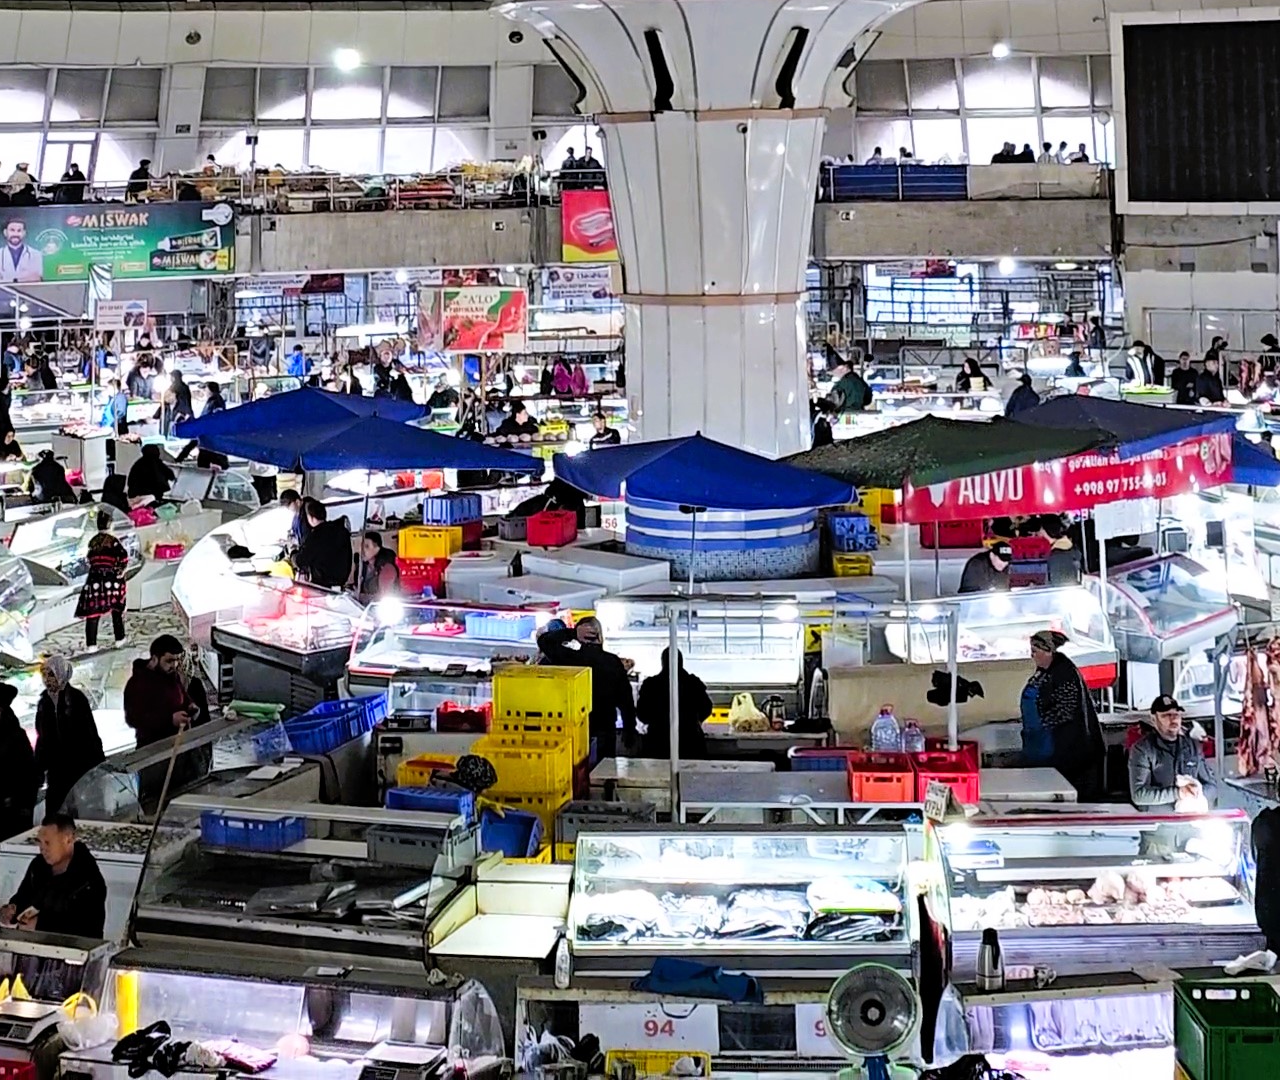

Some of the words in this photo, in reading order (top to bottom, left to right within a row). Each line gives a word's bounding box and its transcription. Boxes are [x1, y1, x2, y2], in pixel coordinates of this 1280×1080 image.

[82, 212, 149, 228] MISWAK
[1074, 480, 1104, 496] +998
[1106, 479, 1120, 493] 97
[644, 1020, 675, 1037] 94
